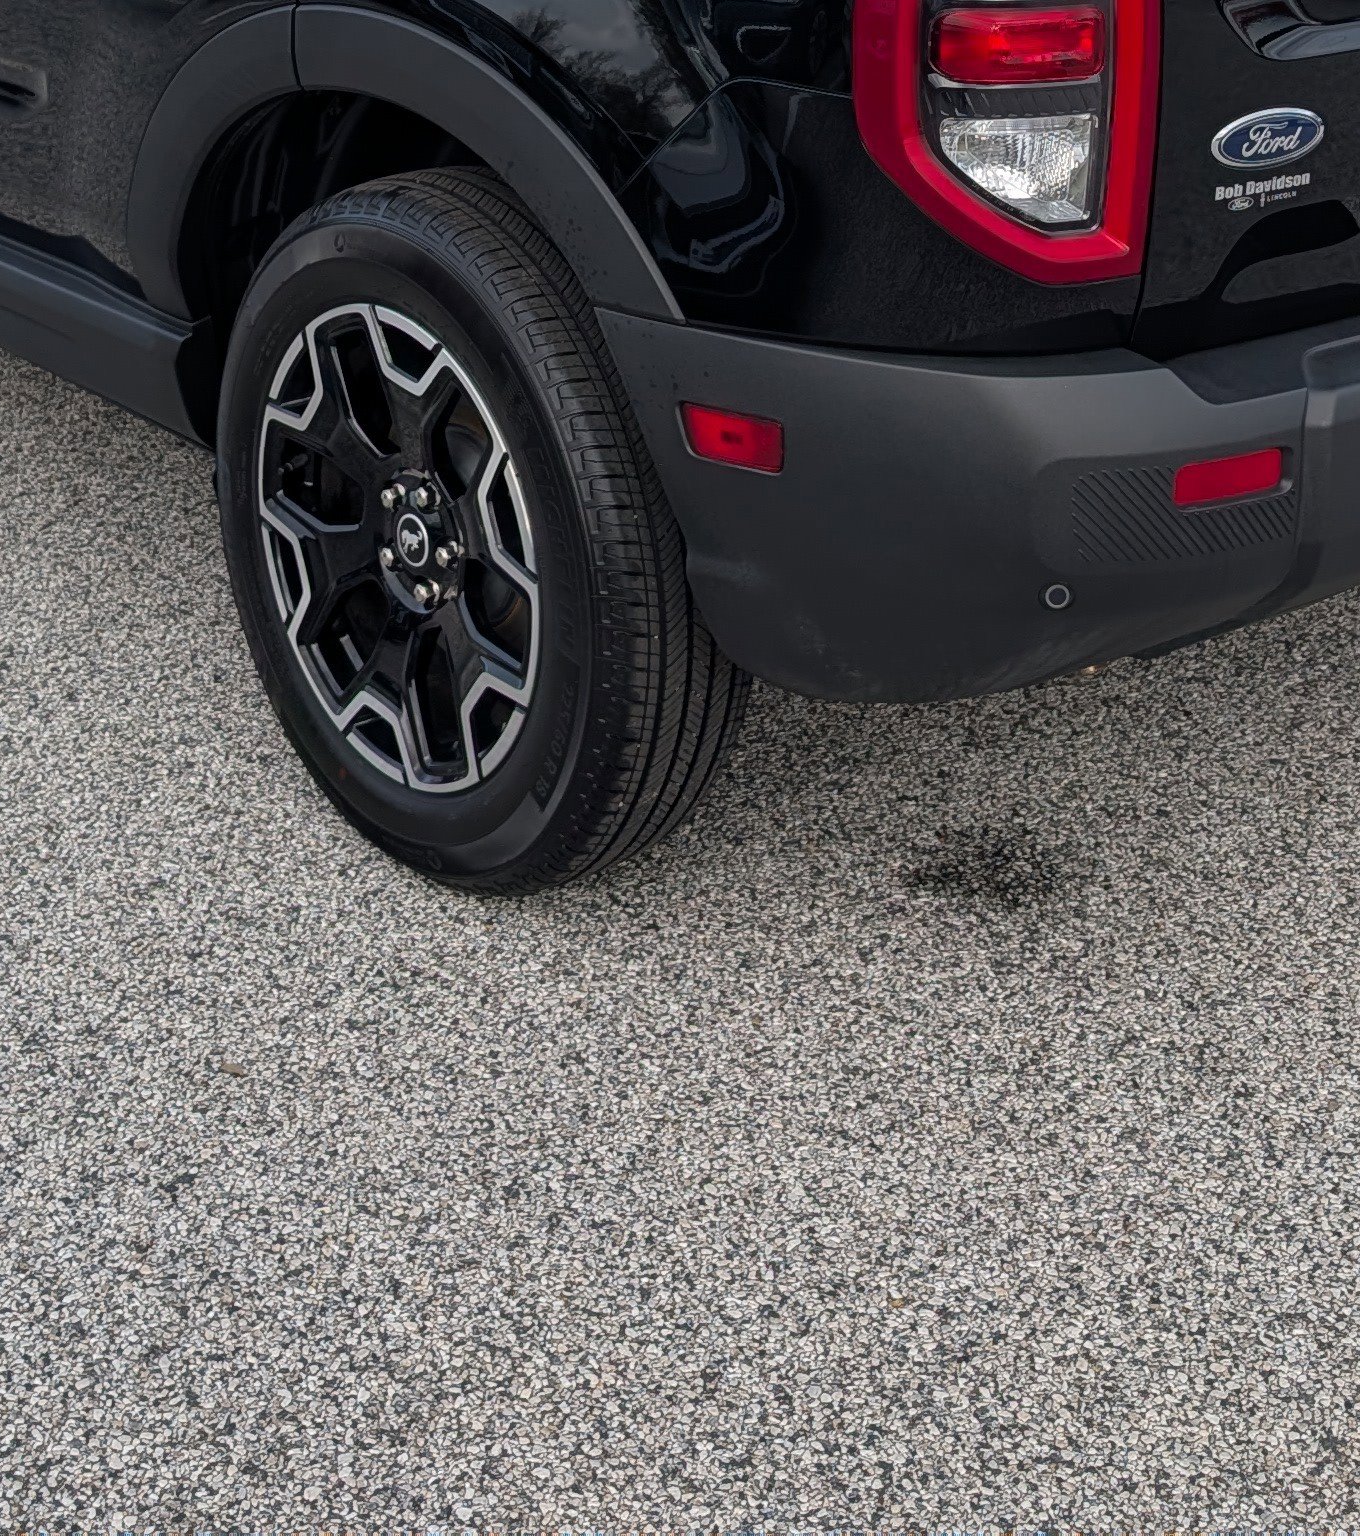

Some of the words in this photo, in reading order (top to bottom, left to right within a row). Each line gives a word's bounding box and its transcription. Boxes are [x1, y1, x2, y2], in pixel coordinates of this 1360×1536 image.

[1242, 122, 1302, 157] Ford
[1215, 184, 1243, 201] Bob
[1245, 173, 1311, 195] Davidson
